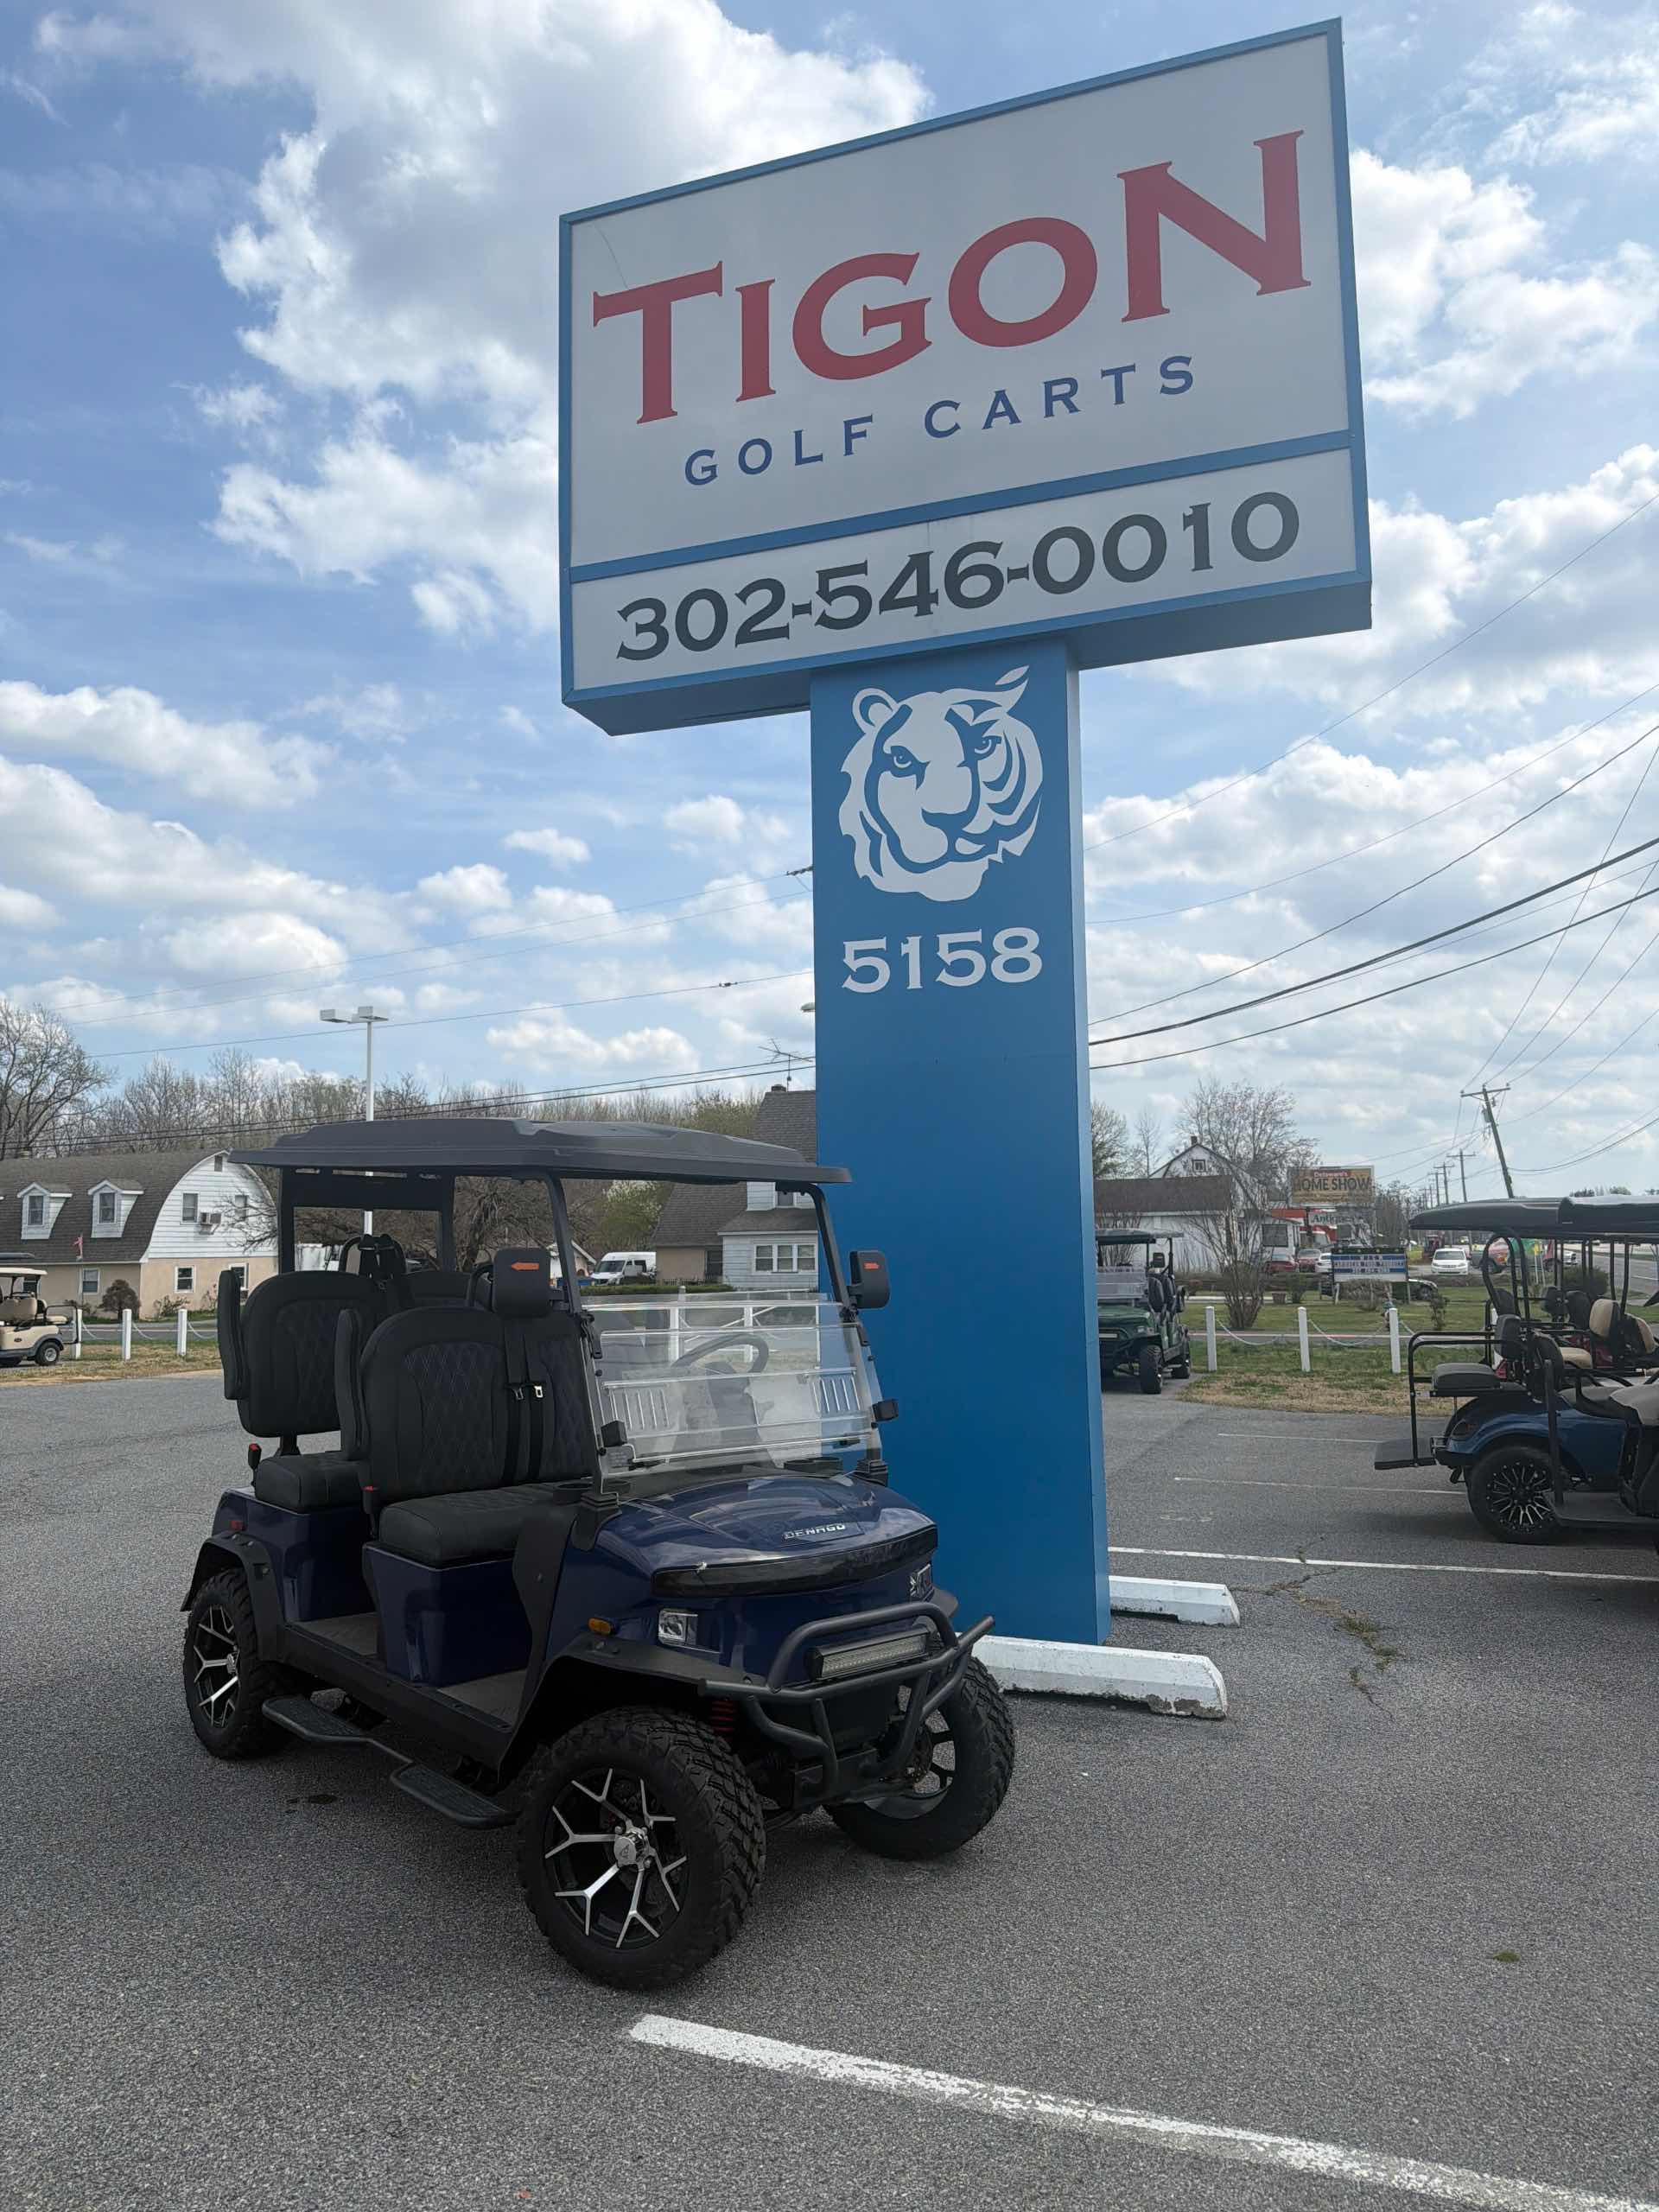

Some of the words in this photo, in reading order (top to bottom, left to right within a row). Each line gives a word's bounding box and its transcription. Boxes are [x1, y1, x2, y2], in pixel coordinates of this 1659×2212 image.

[593, 129, 1311, 425] TIGON
[683, 414, 874, 486] GOLF
[924, 355, 1194, 439] CARTS
[616, 492, 1300, 661] 302-546-0010
[842, 926, 1043, 994] 5158
[1332, 1176, 1370, 1191] SHOW
[784, 1522, 846, 1539] DENAGO
